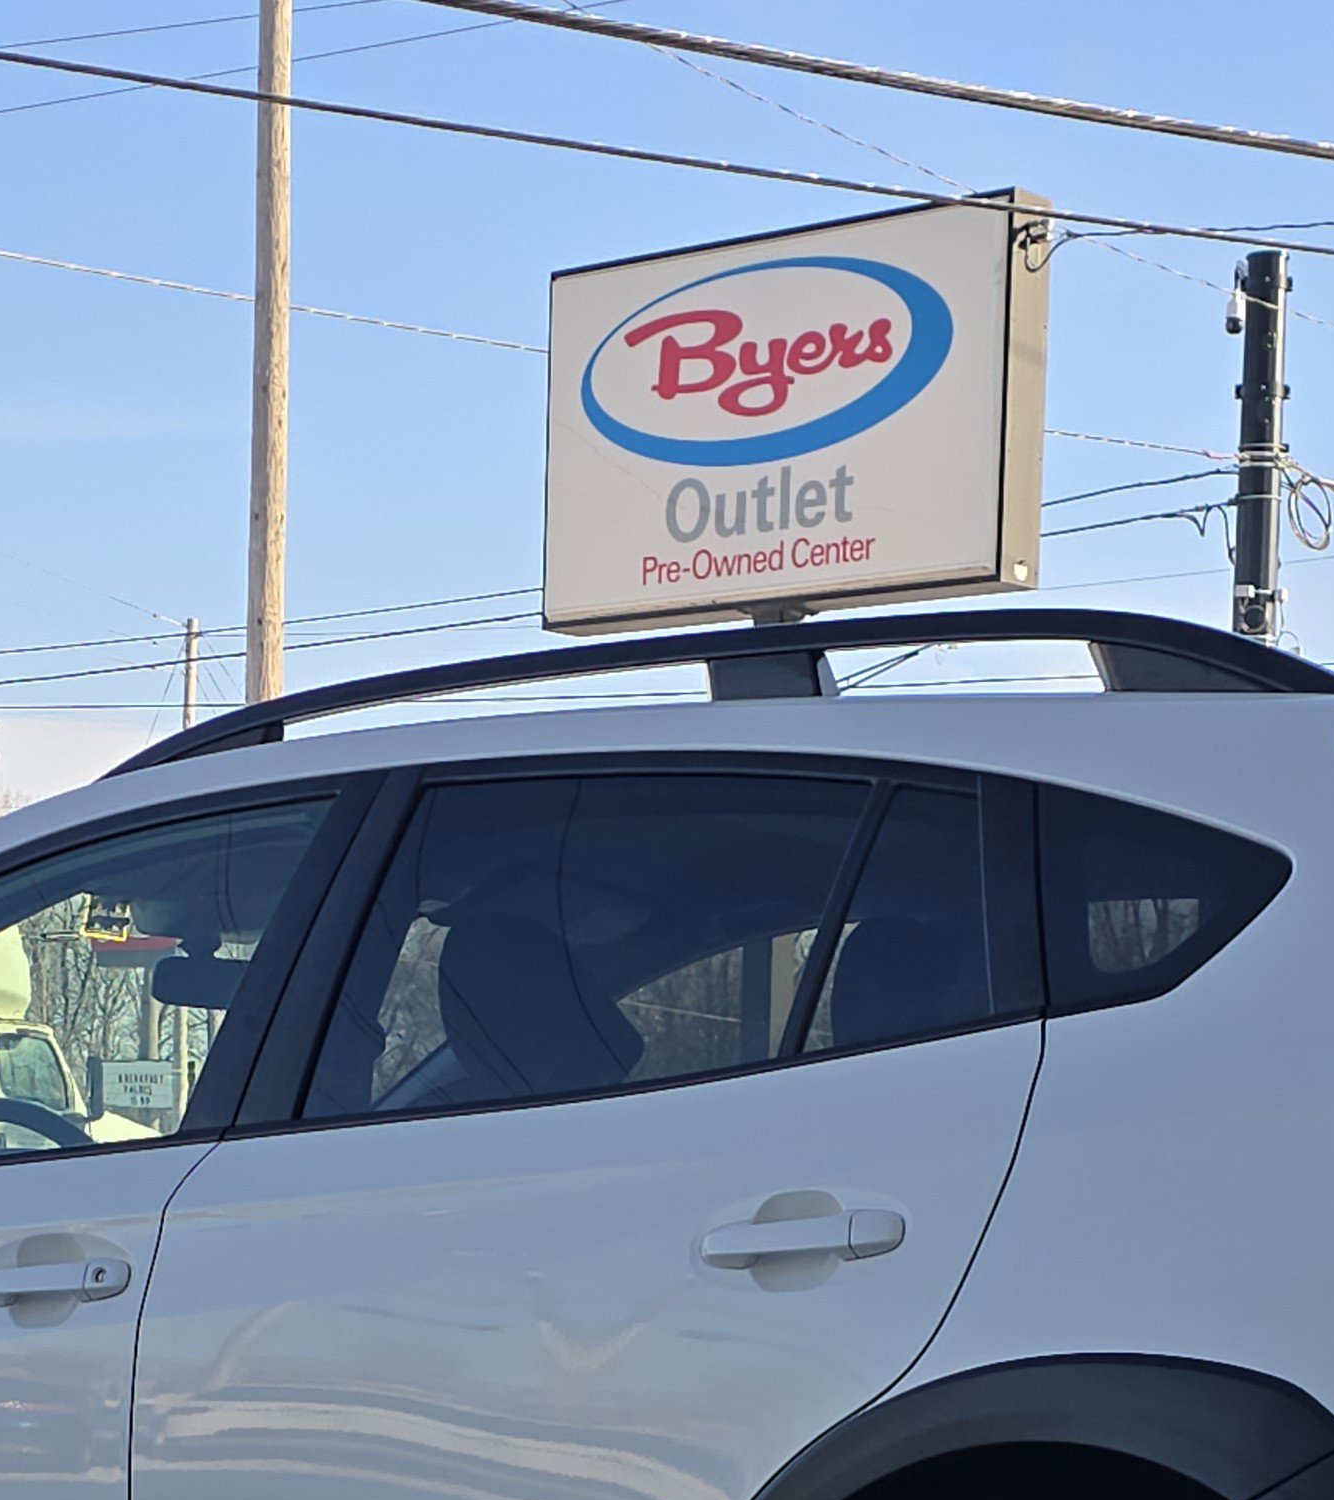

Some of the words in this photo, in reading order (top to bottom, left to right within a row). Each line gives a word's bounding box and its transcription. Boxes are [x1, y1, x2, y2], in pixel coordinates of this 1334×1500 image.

[623, 309, 892, 417] Byers
[666, 464, 854, 543] Outlet
[642, 540, 785, 586] Pre-Owned
[790, 536, 876, 568] Center
